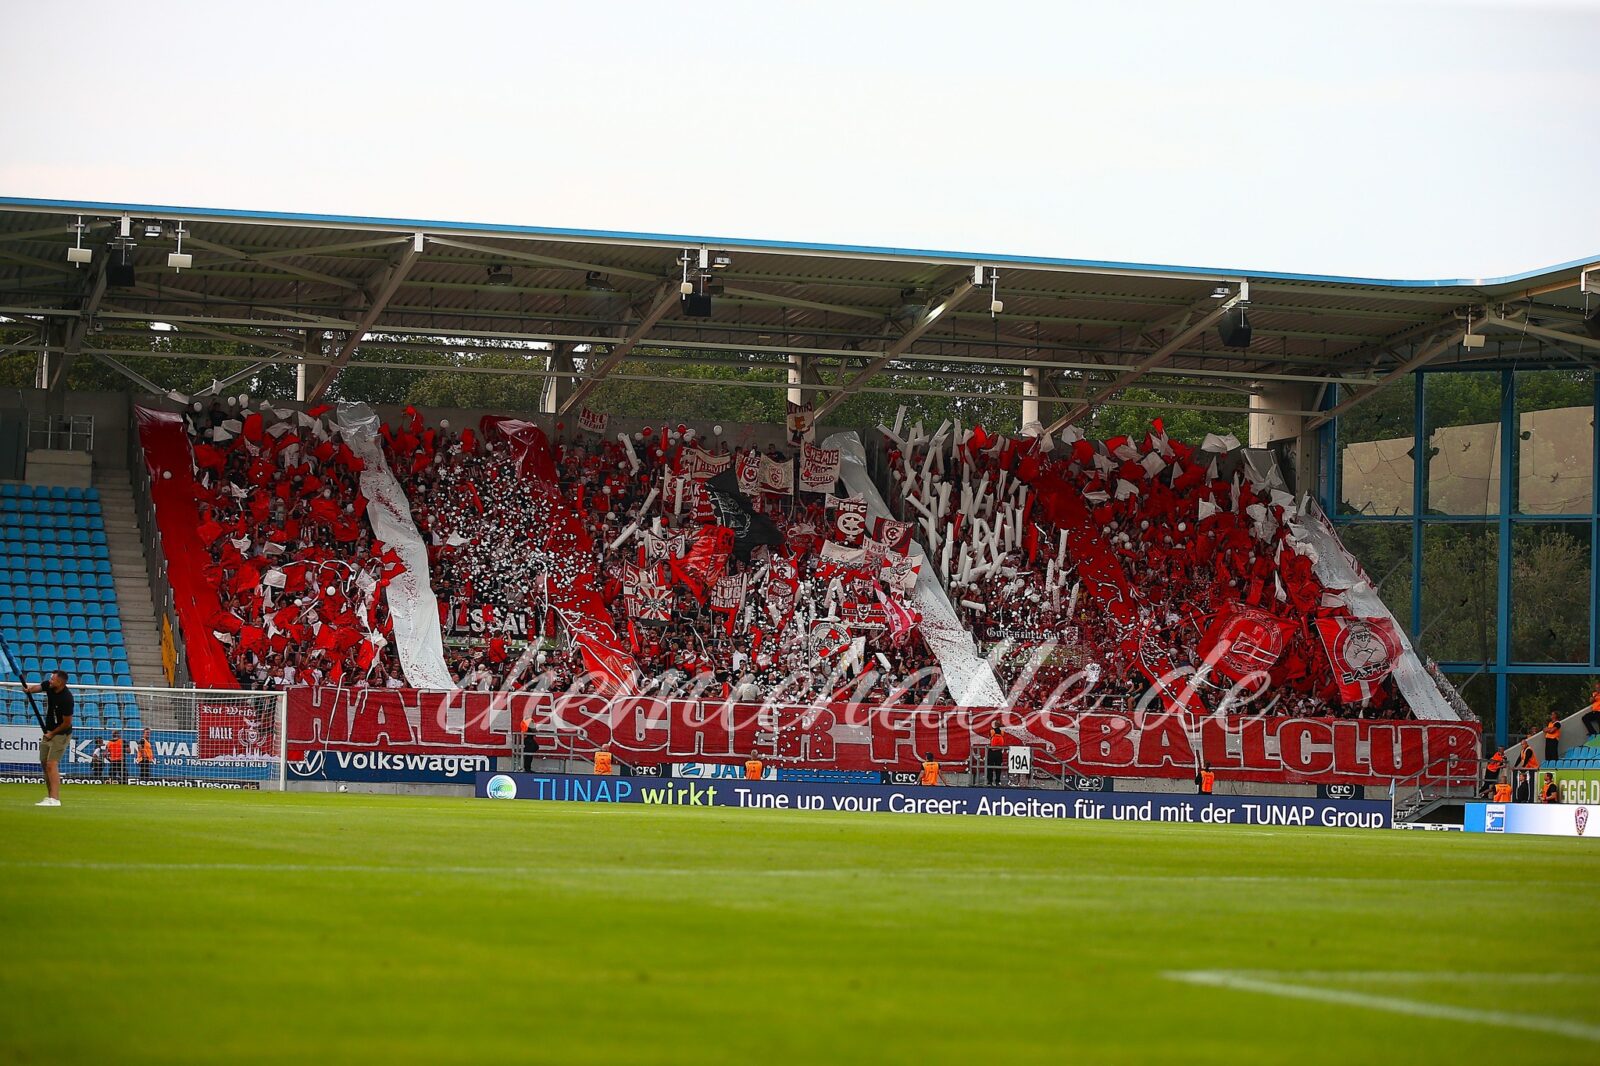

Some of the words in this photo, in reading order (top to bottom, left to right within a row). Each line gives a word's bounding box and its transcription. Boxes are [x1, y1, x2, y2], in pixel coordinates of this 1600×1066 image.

[804, 442, 839, 465] CHEMIE
[840, 502, 867, 513] HFC
[209, 726, 233, 740] HALLE
[283, 686, 836, 762] HALLESCHER
[869, 707, 1482, 780] FUSSBALLCLUB
[164, 758, 183, 766] UND
[336, 750, 490, 777] Volkswagen
[1010, 754, 1029, 771] 19A
[635, 766, 657, 776] CFC
[895, 773, 917, 782] CFC
[1330, 785, 1350, 794] CFC
[534, 778, 632, 803] TUNAP
[641, 781, 726, 807] wirkt.
[734, 787, 789, 809] Tune
[797, 793, 824, 811] up
[833, 795, 882, 813] your
[889, 793, 968, 816] Career:
[976, 796, 1066, 818] Arbeiten
[1074, 799, 1106, 820] für
[1112, 800, 1152, 822] und
[1160, 803, 1194, 823] mit
[1201, 803, 1235, 824] der
[1242, 803, 1315, 826] TUNAP
[1321, 807, 1384, 829] Group
